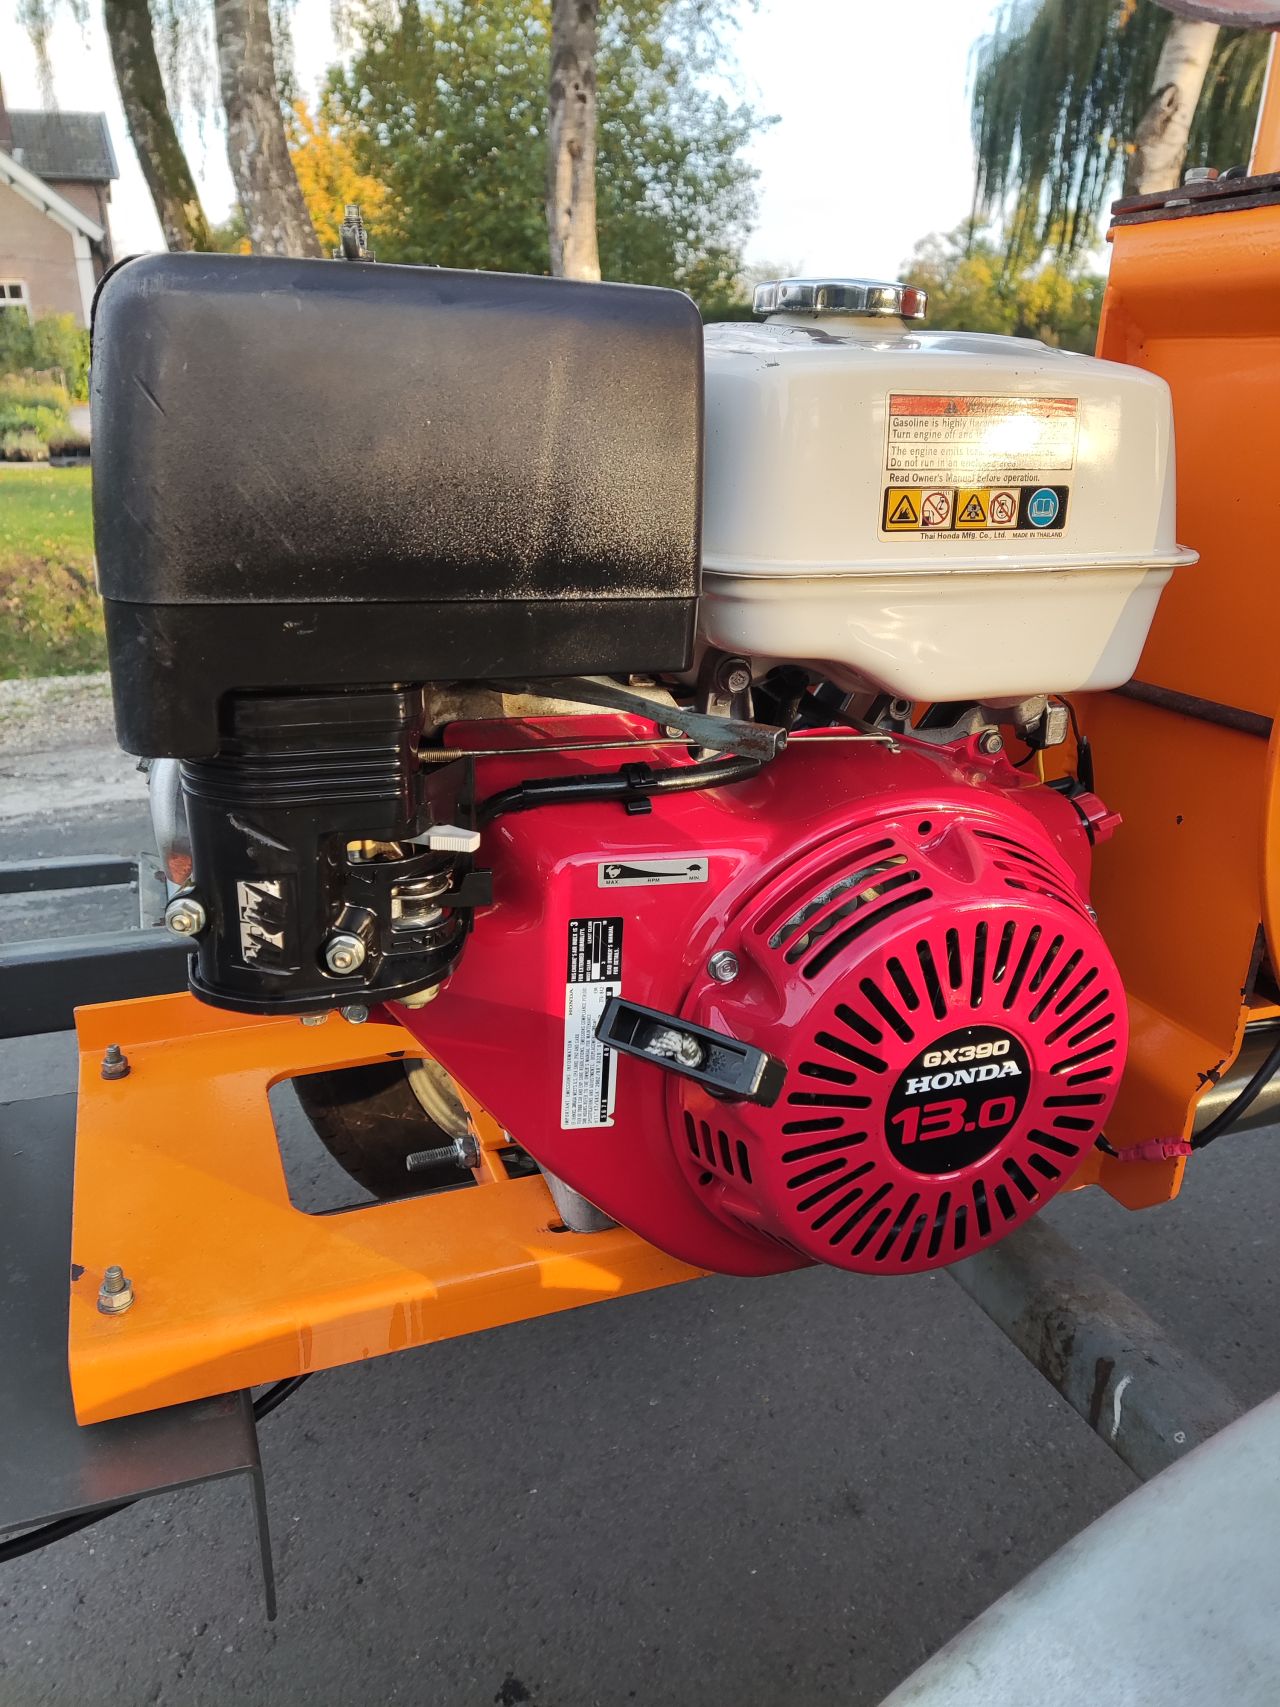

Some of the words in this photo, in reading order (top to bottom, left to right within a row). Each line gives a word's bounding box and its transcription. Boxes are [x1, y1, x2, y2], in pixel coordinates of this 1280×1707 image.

[893, 418, 929, 427] Gasoline
[932, 418, 939, 427] is
[943, 418, 966, 429] highly
[893, 430, 911, 438] Turn
[914, 430, 942, 441] engine
[945, 430, 955, 438] off
[892, 446, 907, 455] The
[910, 446, 937, 457] engine
[891, 458, 901, 467] Do
[905, 457, 918, 467] not
[938, 459, 944, 467] in
[890, 473, 910, 483] Read
[912, 473, 943, 483] Owner's
[946, 473, 974, 483] Manual
[1003, 473, 1040, 484] operation.
[923, 1039, 1010, 1068] GX390
[905, 1060, 1022, 1095] HONDA
[891, 1096, 1016, 1145] 13.0
